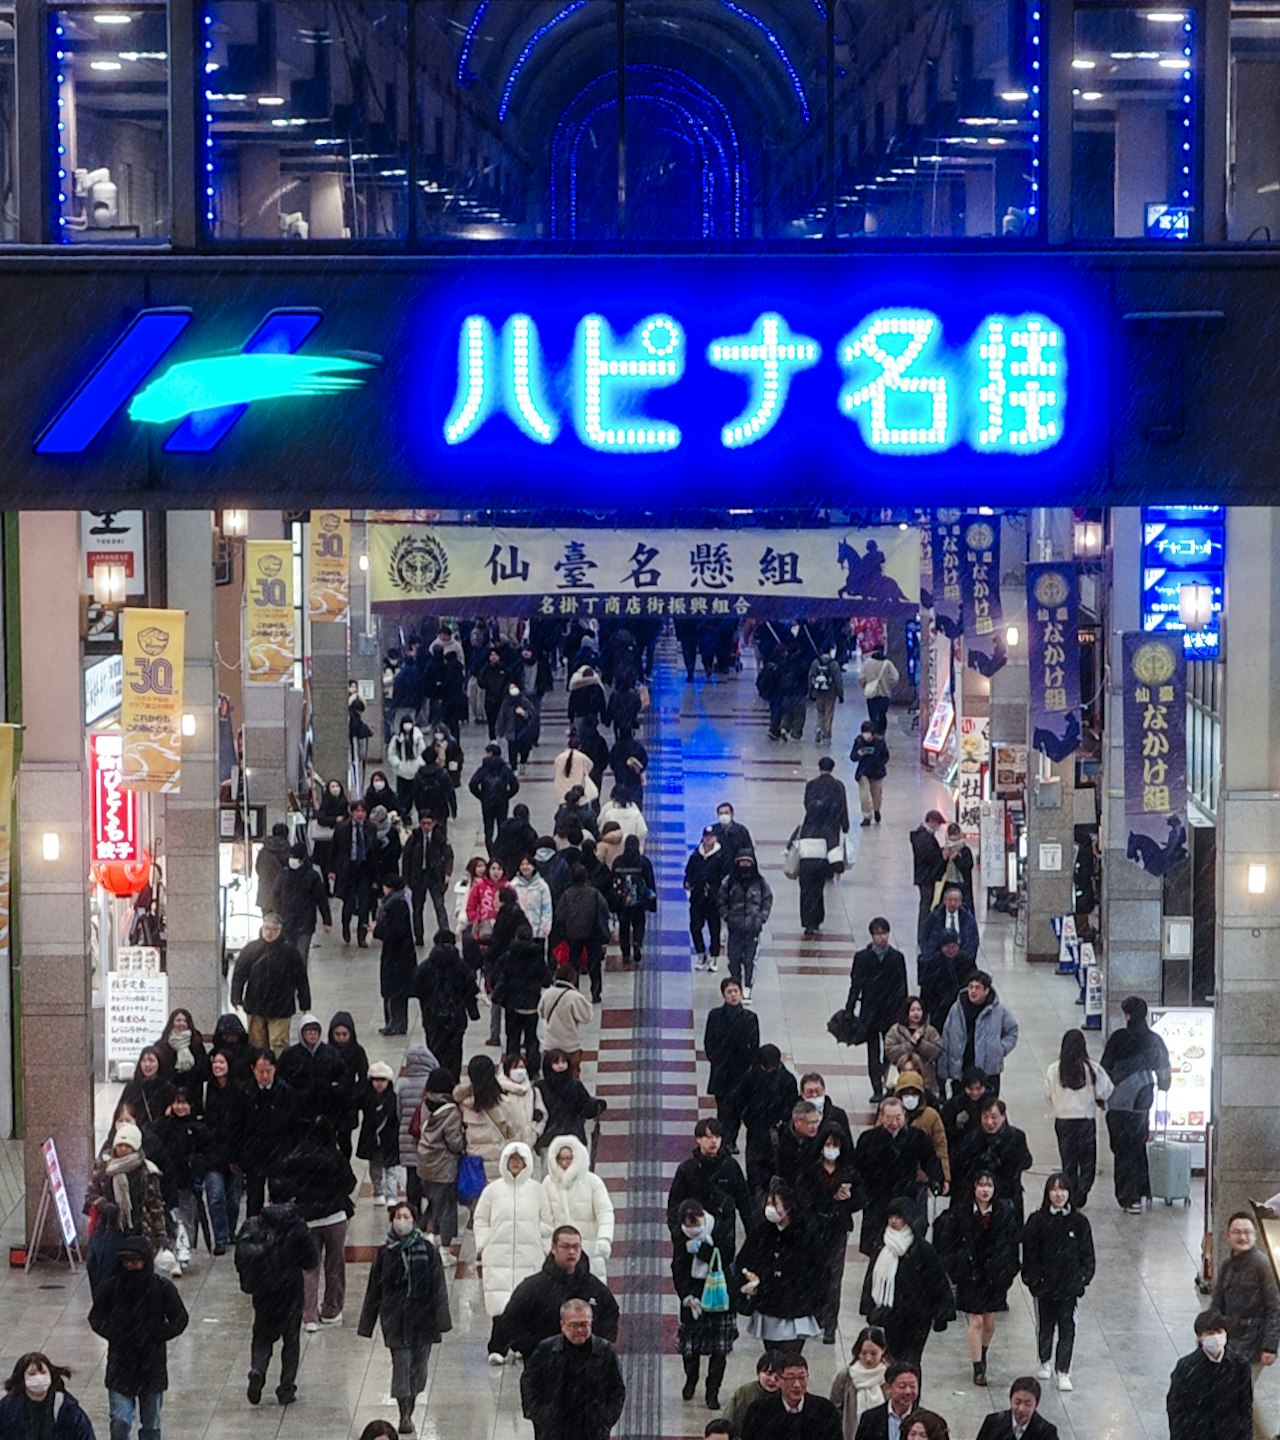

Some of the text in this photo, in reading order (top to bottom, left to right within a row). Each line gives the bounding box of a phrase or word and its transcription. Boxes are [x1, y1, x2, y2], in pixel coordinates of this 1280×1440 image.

[537, 594, 753, 616] 名掛丁商店街振興組合
[1043, 621, 1067, 711] なかけ組
[1141, 703, 1170, 812] なかけ組
